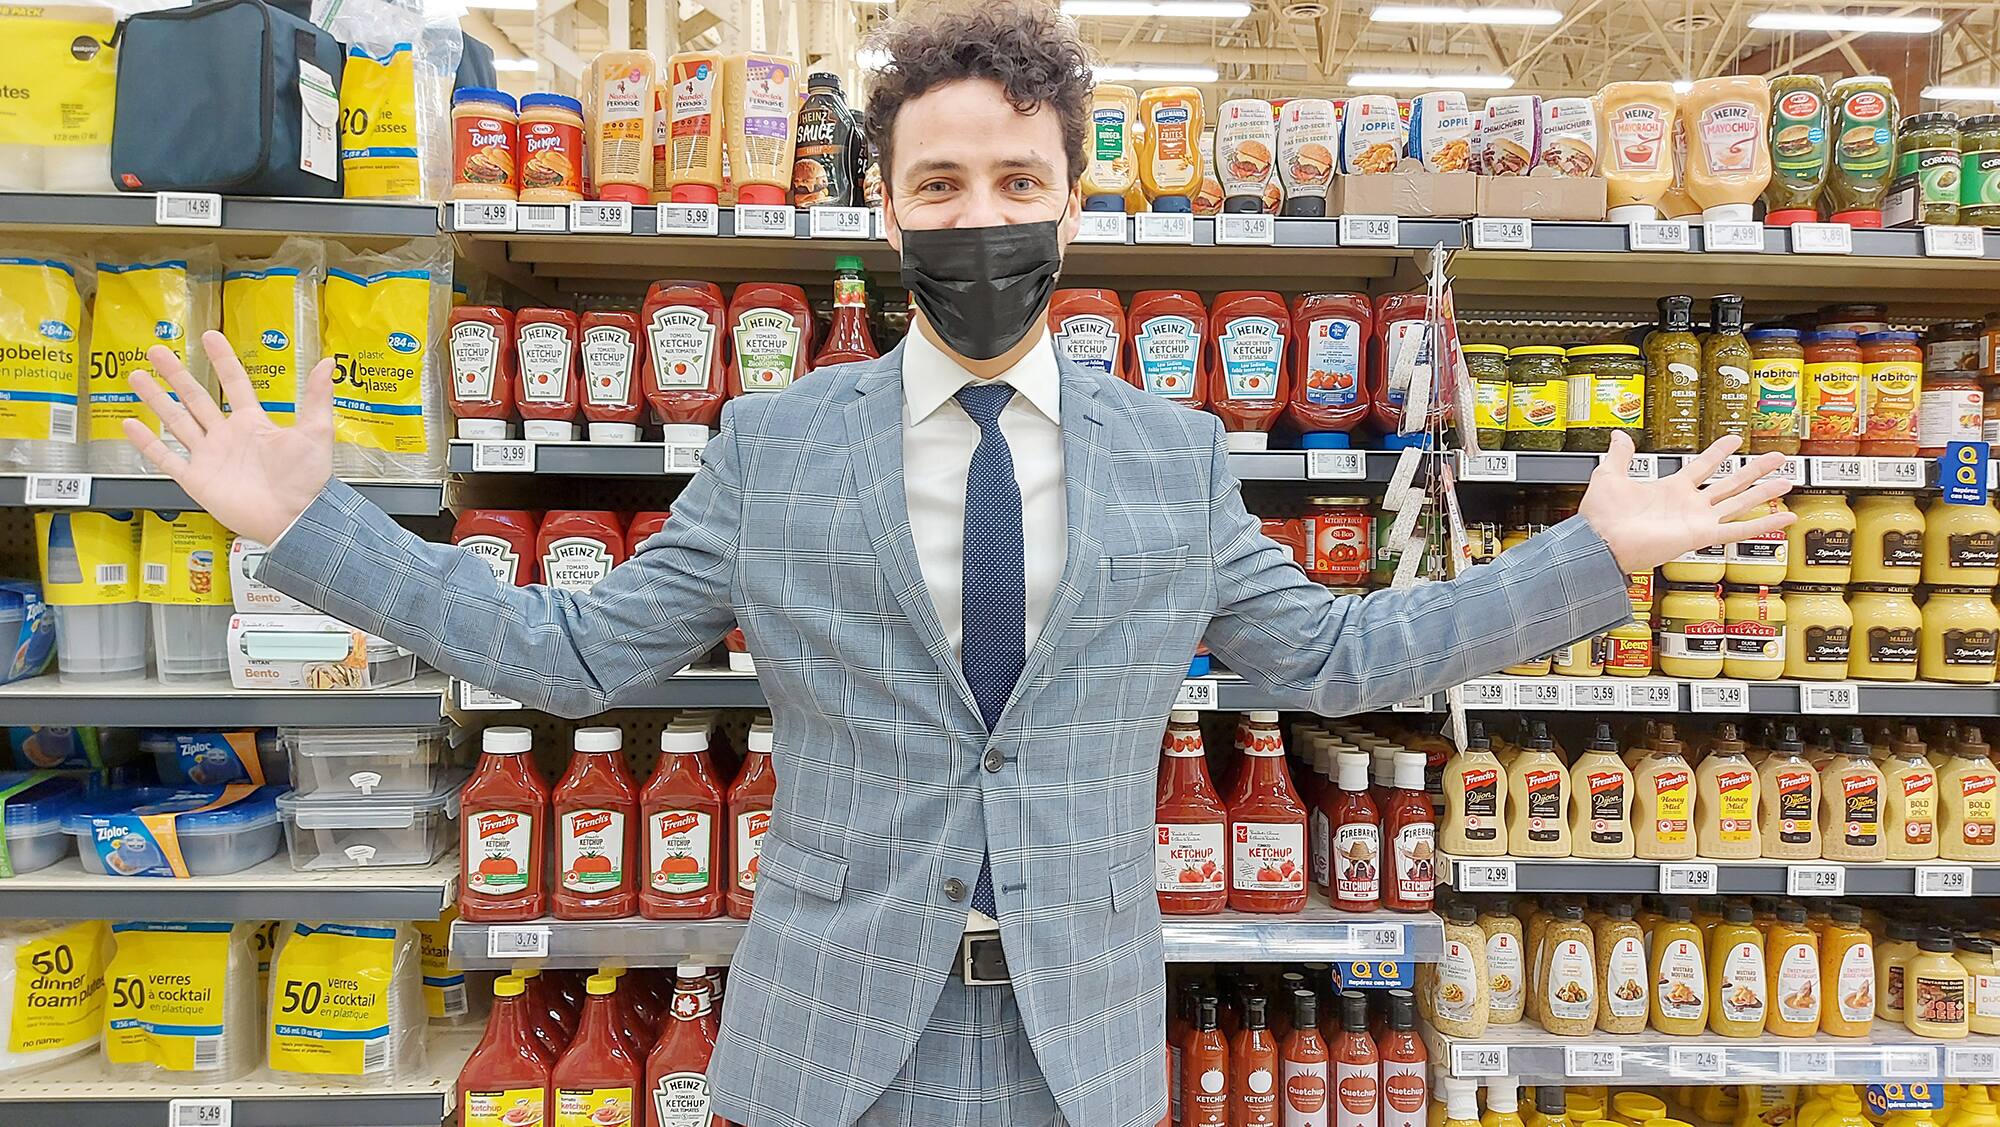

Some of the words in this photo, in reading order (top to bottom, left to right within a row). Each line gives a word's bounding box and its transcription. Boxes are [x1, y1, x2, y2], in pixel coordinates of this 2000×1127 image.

[1626, 110, 1655, 119] HEINZ
[1714, 109, 1747, 119] HEINZ
[1360, 122, 1395, 132] JOPPIE
[1438, 118, 1468, 128] JOPPIE
[1484, 119, 1525, 133] CHIMICHURRI
[1619, 123, 1659, 133] MAYORACHA
[1706, 122, 1755, 134] MAYOCHUP
[798, 124, 835, 142] SAUCE
[472, 133, 506, 147] Burger
[528, 136, 560, 152] Burger
[186, 200, 210, 214] 14,99
[485, 204, 505, 220] 4,99
[599, 206, 621, 222] 5,99
[686, 209, 708, 224] 5,99
[763, 210, 785, 225] 5,99
[839, 212, 859, 226] 3,99
[1096, 219, 1117, 231] 4,49
[1162, 219, 1184, 231] 4,49
[1245, 221, 1264, 233] 3,49
[1369, 222, 1389, 234] 3,49
[1502, 224, 1522, 237] 3,49
[1659, 225, 1680, 239] 4,99
[1733, 227, 1754, 239] 4,99
[1954, 233, 1973, 245] 2,99
[664, 316, 696, 326] HEINZ
[750, 318, 782, 329] HEINZ
[458, 328, 486, 338] HEINZ
[528, 330, 558, 340] HEINZ
[1072, 324, 1104, 334] HEINZ
[1153, 325, 1185, 334] HEINZ
[1238, 326, 1269, 335] HEINZ
[388, 337, 406, 347] 284
[592, 333, 622, 343] HEINZ
[660, 340, 702, 348] KETCHUP
[746, 340, 787, 348] KETCHUP
[527, 350, 562, 358] KETCHUP
[1067, 345, 1107, 353] KETCHUP
[1150, 345, 1189, 353] KETCHUP
[1233, 346, 1273, 355] KETCHUP
[359, 351, 384, 360] plastic
[590, 353, 625, 361] KETCHUP
[91, 351, 118, 379] 50
[15, 366, 72, 381] plastique
[360, 363, 413, 382] beverage
[1754, 370, 1800, 378] Habitant
[1815, 374, 1859, 382] Habitant
[502, 446, 525, 461] 3,99
[1336, 455, 1357, 468] 2,99
[1488, 458, 1507, 470] 1,79
[1629, 459, 1648, 472] 2,79
[1840, 464, 1859, 474] 4,49
[1896, 464, 1915, 474] 4,49
[57, 480, 78, 494] 5,49
[560, 547, 594, 558] HEINZ
[556, 570, 600, 579] KETCHUP
[246, 593, 281, 602] Bento
[1620, 640, 1648, 651] Keen's
[245, 669, 280, 678] Bento
[1188, 687, 1208, 698] 2,99
[1481, 686, 1500, 698] 3,59
[1538, 686, 1557, 698] 3,59
[1593, 686, 1613, 699] 3,59
[1650, 687, 1669, 700] 2,99
[1719, 688, 1739, 701] 3,49
[1829, 691, 1848, 701] 5,89
[181, 743, 211, 755] Ziploc
[1466, 772, 1495, 785] French's
[1529, 773, 1558, 786] French's
[1592, 776, 1621, 788] French's
[1658, 776, 1686, 789] French's
[1721, 773, 1749, 788] French's
[1780, 776, 1809, 789] French's
[1846, 777, 1875, 791] French's
[1466, 792, 1495, 805] Dijon
[1661, 796, 1684, 804] Honey
[482, 817, 515, 832] French's
[575, 815, 608, 830] French's
[664, 815, 695, 831] French's
[96, 827, 128, 840] Ziploc
[1171, 848, 1213, 859] KETCHUP
[1249, 848, 1292, 858] KETCHUP
[1487, 869, 1506, 880] 2,99
[1689, 871, 1708, 883] 2,99
[1816, 873, 1835, 884] 2,99
[1944, 874, 1962, 885] 2,99
[517, 933, 538, 945] 3,79
[1376, 931, 1395, 942] 4,99
[32, 945, 74, 974] 50
[31, 974, 85, 990] dinner
[149, 975, 191, 985] verres
[328, 979, 358, 990] verres
[114, 977, 145, 1009] 50
[149, 990, 154, 1000] à
[159, 988, 211, 1002] cocktail
[282, 980, 321, 1014] 50
[28, 992, 76, 1008] foam
[323, 993, 330, 1004] à
[334, 993, 375, 1006] cocktail
[162, 1005, 203, 1016] plastique
[1926, 1001, 1956, 1011] JOE
[334, 1009, 368, 1020] plastique
[1925, 1010, 1964, 1019] BEEF
[23, 1040, 33, 1048] no
[36, 1037, 60, 1045] name
[1479, 1053, 1499, 1064] 2,49
[1697, 1054, 1716, 1064] 2,49
[670, 1081, 700, 1090] HEINZ
[199, 1107, 220, 1121] 5,49
[471, 1104, 501, 1112] ketchup
